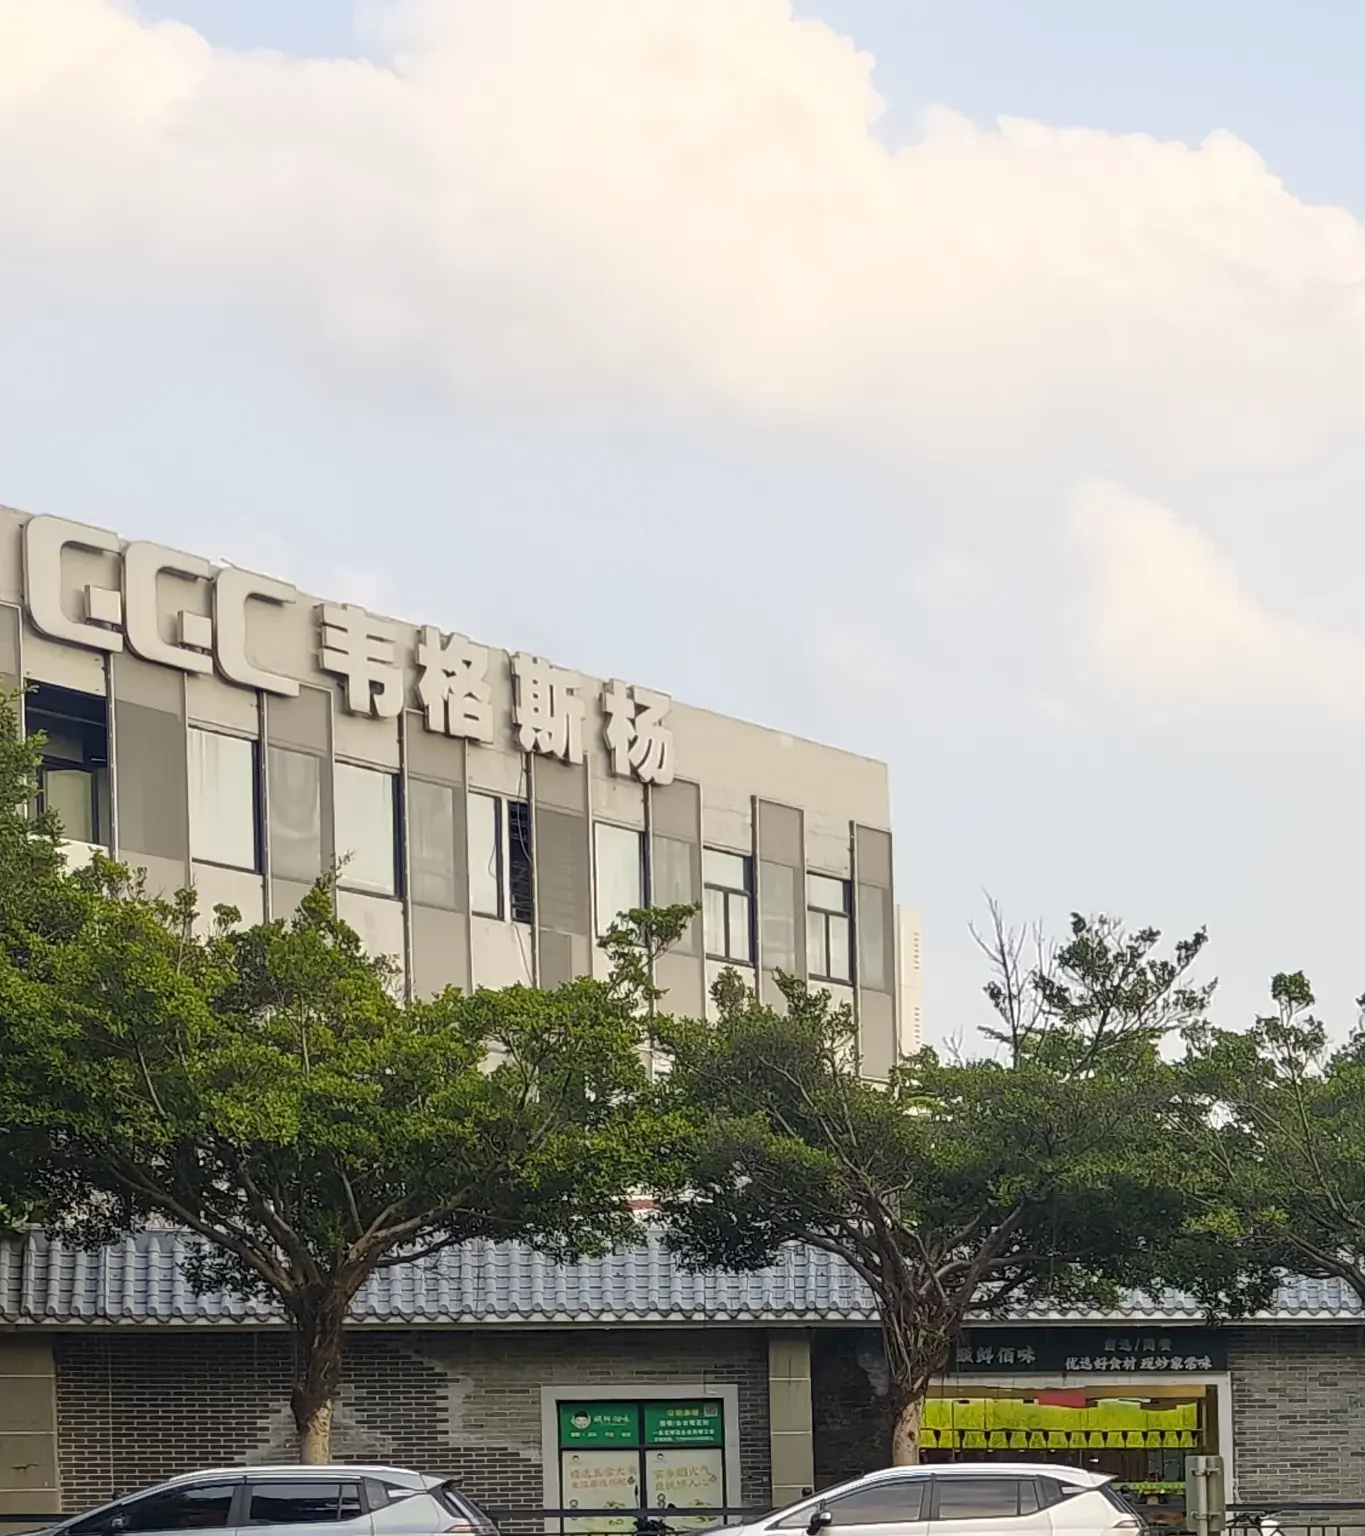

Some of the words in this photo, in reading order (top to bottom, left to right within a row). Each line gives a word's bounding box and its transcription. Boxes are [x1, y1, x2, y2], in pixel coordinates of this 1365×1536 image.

[314, 602, 676, 786] 韦格斯杨
[1065, 1356, 1137, 1371] 优选好食材
[1140, 1355, 1213, 1371] 现炒家常味
